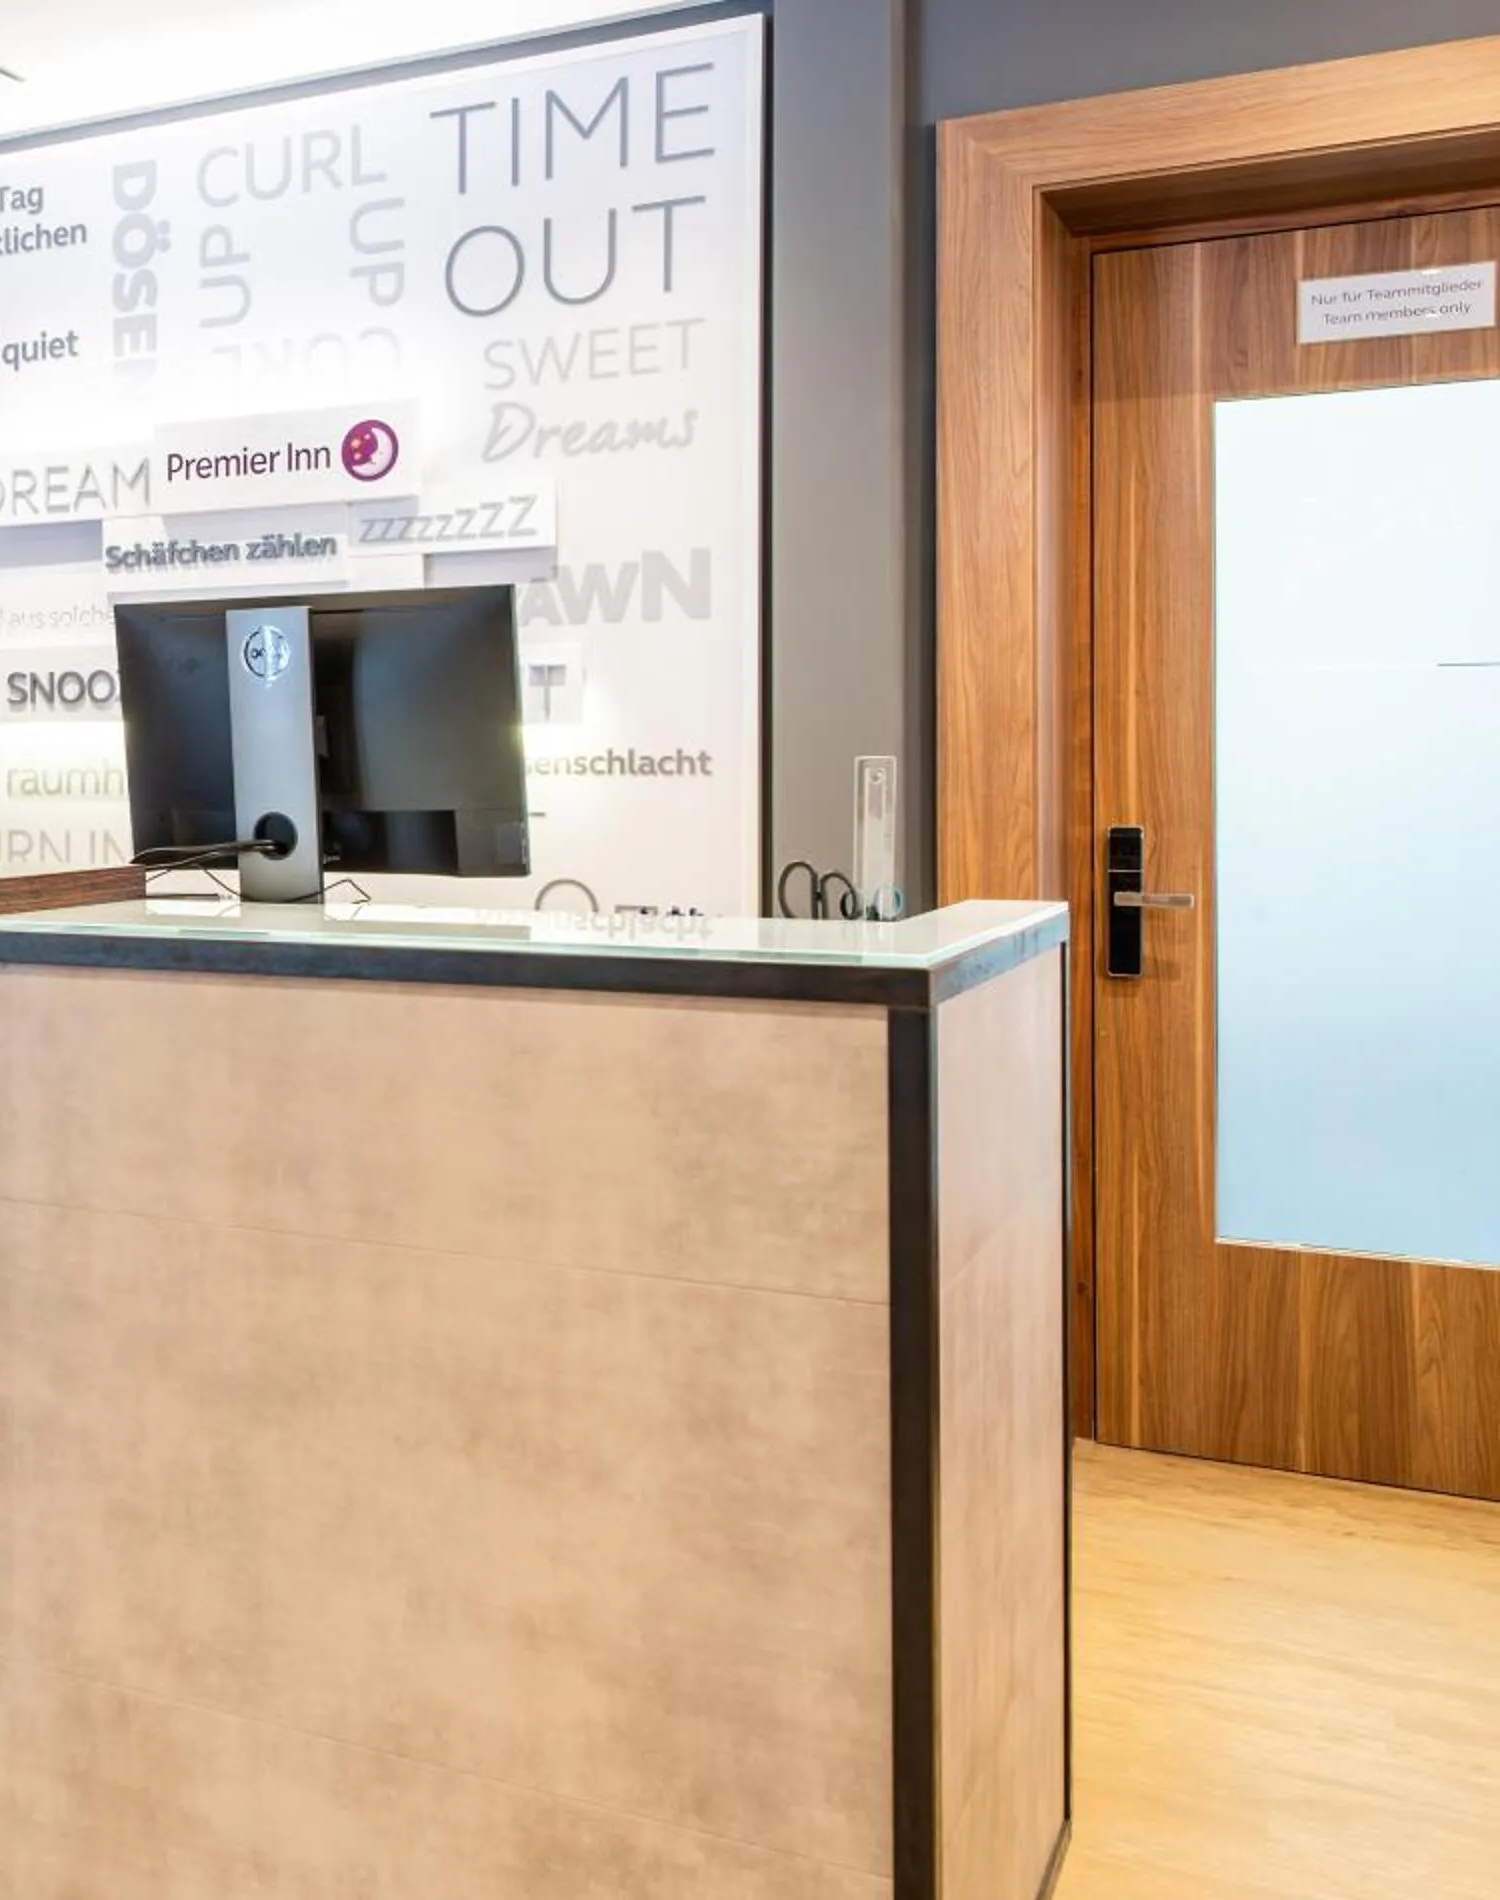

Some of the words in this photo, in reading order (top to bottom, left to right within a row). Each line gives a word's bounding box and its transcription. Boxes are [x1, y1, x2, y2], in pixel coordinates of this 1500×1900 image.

[429, 61, 715, 196] TIME
[196, 124, 387, 208] CURL
[199, 223, 252, 327] UP
[348, 196, 405, 307] UP
[445, 195, 707, 318] OUT
[1311, 293, 1338, 306] Nur
[1342, 290, 1362, 303] für
[1368, 278, 1483, 301] Teammitglieder
[1323, 312, 1363, 326] Team
[1365, 305, 1437, 322] members
[1440, 300, 1473, 316] only
[2, 329, 78, 371] quiet
[483, 318, 706, 391] SWEET
[167, 447, 280, 482] Premier
[287, 442, 331, 472] Inn
[480, 401, 699, 464] Dreams
[106, 537, 239, 567] Schäfchen
[247, 532, 336, 559] zählen
[518, 547, 712, 627] AWN
[7, 669, 118, 705] SNOO
